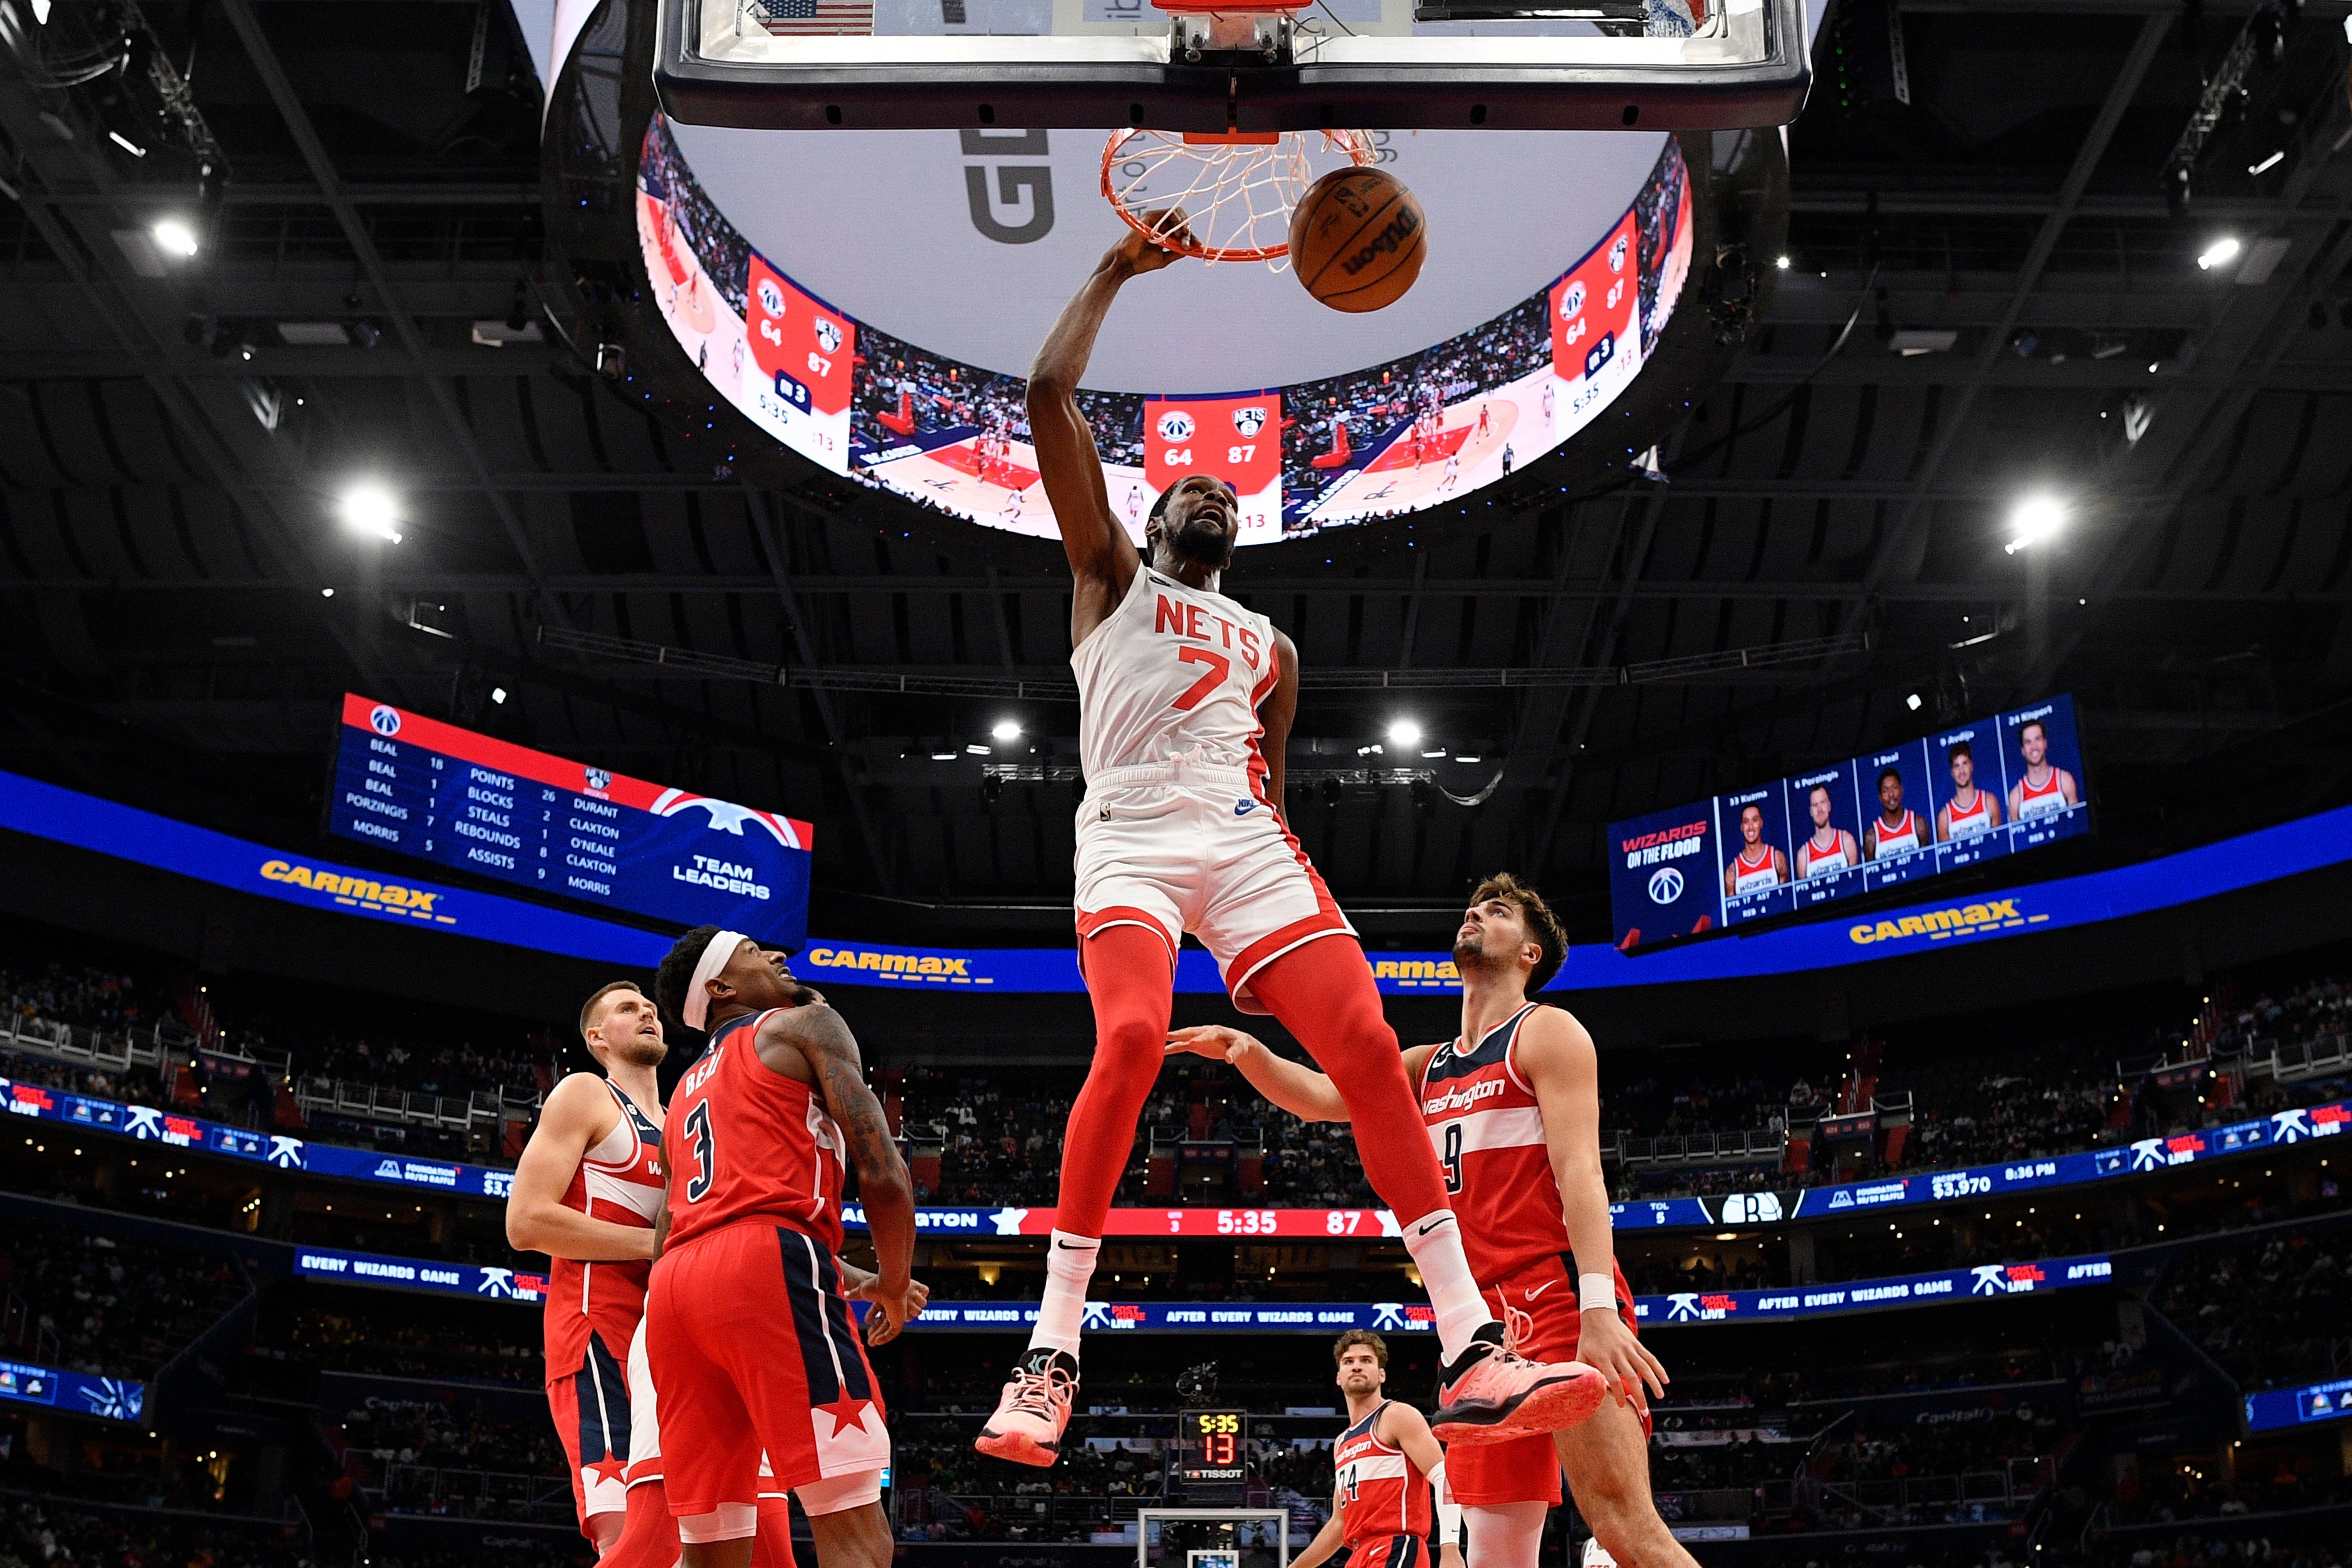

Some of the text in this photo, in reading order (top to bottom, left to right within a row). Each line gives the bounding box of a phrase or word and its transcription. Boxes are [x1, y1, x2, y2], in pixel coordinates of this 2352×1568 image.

[1607, 278, 1624, 309] 87
[760, 319, 782, 347] 64
[1566, 318, 1586, 345] 64
[1601, 338, 1610, 358] 3
[807, 352, 832, 377] 87
[795, 384, 806, 404] 3
[1573, 382, 1600, 414] 5:35
[760, 394, 788, 424] 5:35
[1233, 410, 1265, 424] NETS
[1164, 444, 1256, 466] 64 87
[1155, 593, 1260, 671] NETS
[1171, 645, 1230, 711] 7
[370, 738, 619, 819] BEAL 18 POINTS 26 DURANT
[368, 760, 619, 840] BEAL 1 BLOCKS 2 CLAXTON
[1730, 798, 1740, 807] 33
[365, 778, 615, 858] BEAL 1 STEALS 1 O'NEALE
[346, 792, 617, 875] PORZINGIS 7 REBOUNDS 8 CLAXTON
[1623, 820, 1707, 853] WIZARDS
[353, 819, 399, 842] MORRIS
[468, 847, 515, 869] ASSISTS
[538, 868, 545, 879] 9
[568, 875, 610, 896] MORRIS
[1628, 836, 1701, 869] ON THE FLOOR
[693, 854, 753, 881] TEAM
[673, 865, 770, 900] LEADERS
[1727, 901, 1740, 909] PTS
[1367, 961, 1460, 978] Rma
[9, 1099, 39, 1117] LIVE
[2312, 1120, 2341, 1137] LIVE
[162, 1130, 190, 1147] LIVE
[684, 1097, 715, 1204] 3
[1442, 1121, 1464, 1196] 9
[2168, 1149, 2194, 1166] LIVE
[484, 1171, 515, 1182] JACKPO
[2036, 1163, 2056, 1176] PM
[1933, 1176, 1991, 1200] $3,970
[1649, 1202, 1669, 1211] TOL
[1171, 1220, 1179, 1232] 3
[1217, 1211, 1277, 1234] 5:35
[1326, 1211, 1361, 1235] 87
[1656, 1211, 1665, 1224] 5
[301, 1255, 459, 1285] EVERY WIZARDS GAME
[514, 1274, 543, 1283] POST
[2067, 1262, 2111, 1279] AFTER
[512, 1288, 538, 1302] LIVE
[1758, 1280, 1952, 1310] AFTER EVERY WIZARDS GAME
[2007, 1279, 2034, 1293] LIVE
[1701, 1295, 1729, 1305] POST
[1706, 1302, 1737, 1310] GAME
[918, 1310, 1019, 1321] EVERY WIZARDS
[1112, 1306, 1139, 1314] POST
[1116, 1312, 1146, 1320] GAME
[1166, 1312, 1354, 1323] AFTER EVERY WIZARDS GAME
[1405, 1307, 1432, 1315] POST
[1701, 1309, 1726, 1320] LIVE
[1111, 1319, 1135, 1329] LIVE
[1404, 1320, 1429, 1330] LIVE
[1200, 1414, 1238, 1433] 5:35
[1206, 1434, 1233, 1464] 13
[1200, 1470, 1243, 1478] TISSOT
